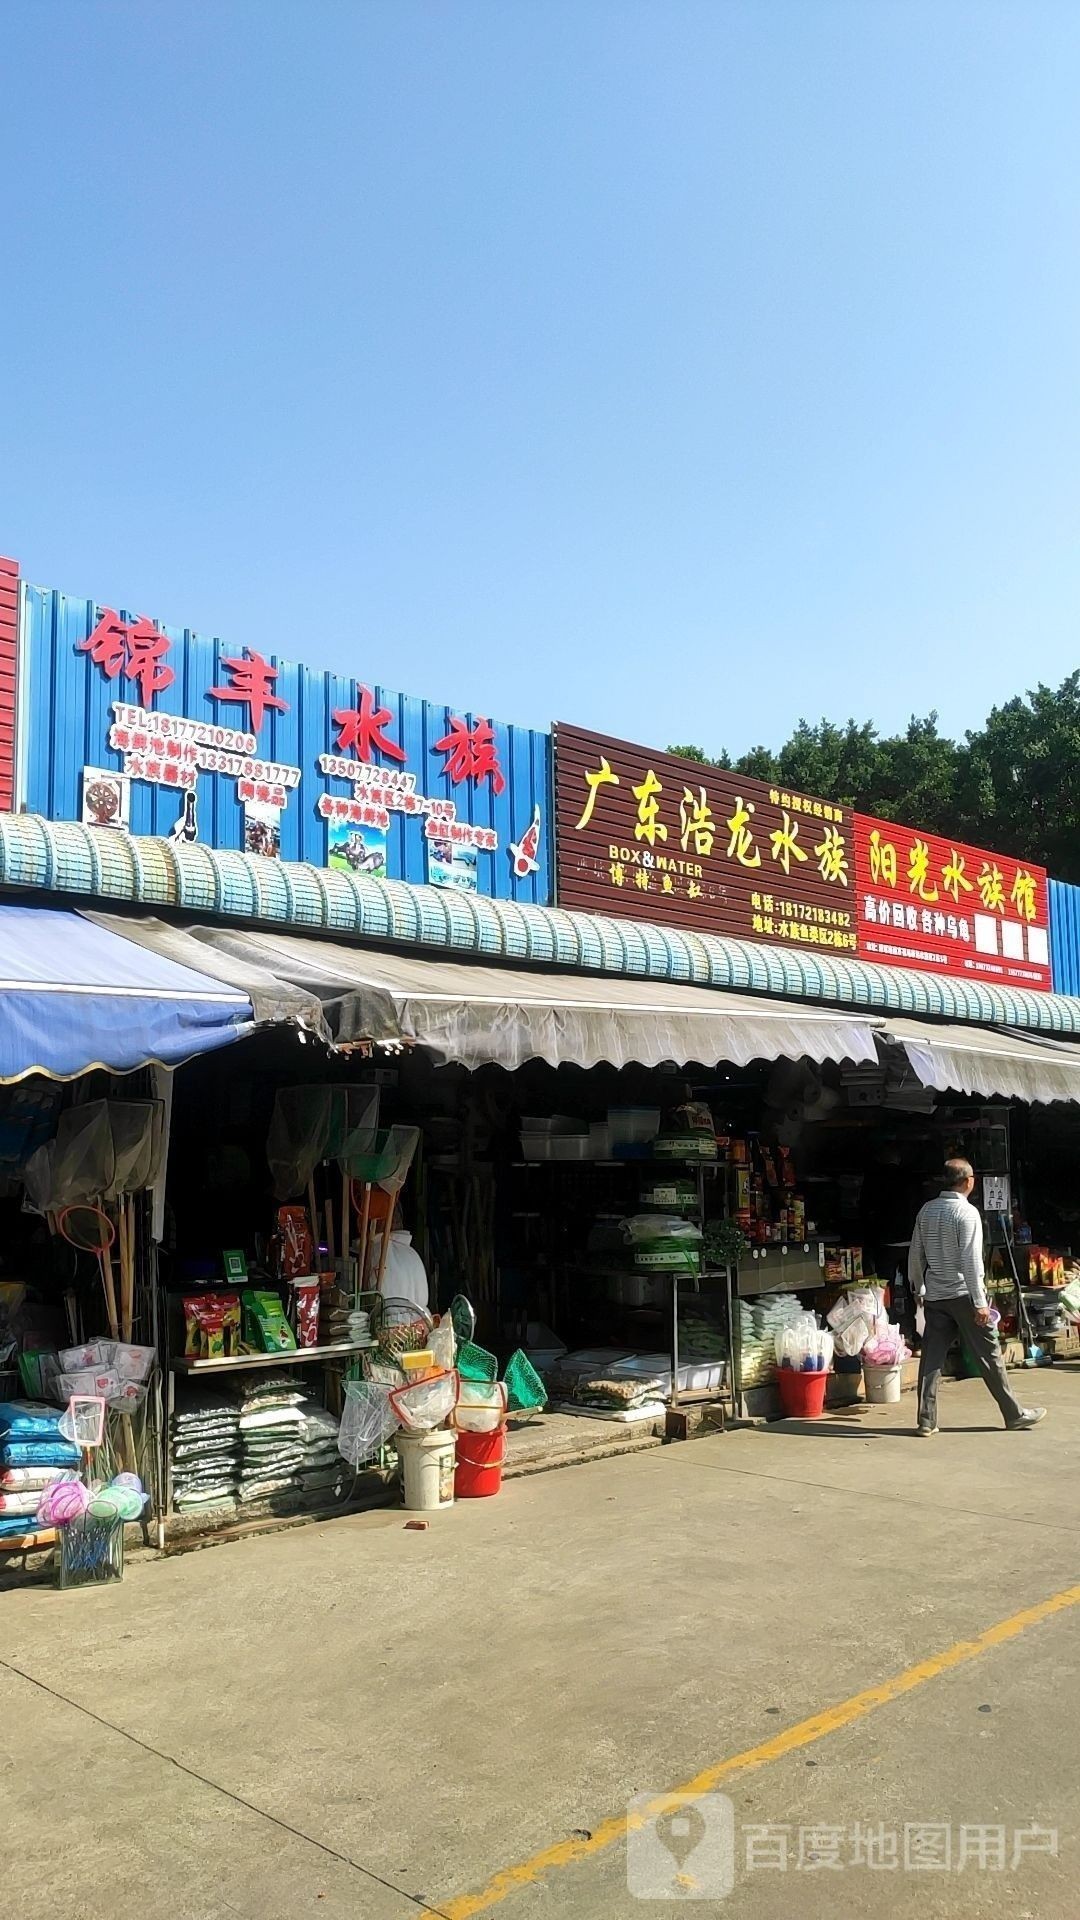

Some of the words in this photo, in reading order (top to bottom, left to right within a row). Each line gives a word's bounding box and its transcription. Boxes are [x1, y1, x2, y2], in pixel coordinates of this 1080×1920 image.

[78, 606, 505, 795] 锦丰水族
[126, 756, 196, 789] 水族器材
[240, 781, 286, 807] 陶瓷品
[769, 788, 843, 823] 特约授权经销商
[321, 796, 389, 828] 各种海鲜池
[575, 755, 848, 886] 广东浩龙水族
[427, 820, 496, 848] 鱼缸制作专家
[609, 845, 702, 878] BOX&WATER
[869, 829, 1037, 923] 阳光水族馆
[608, 861, 703, 899] 博特鱼缸
